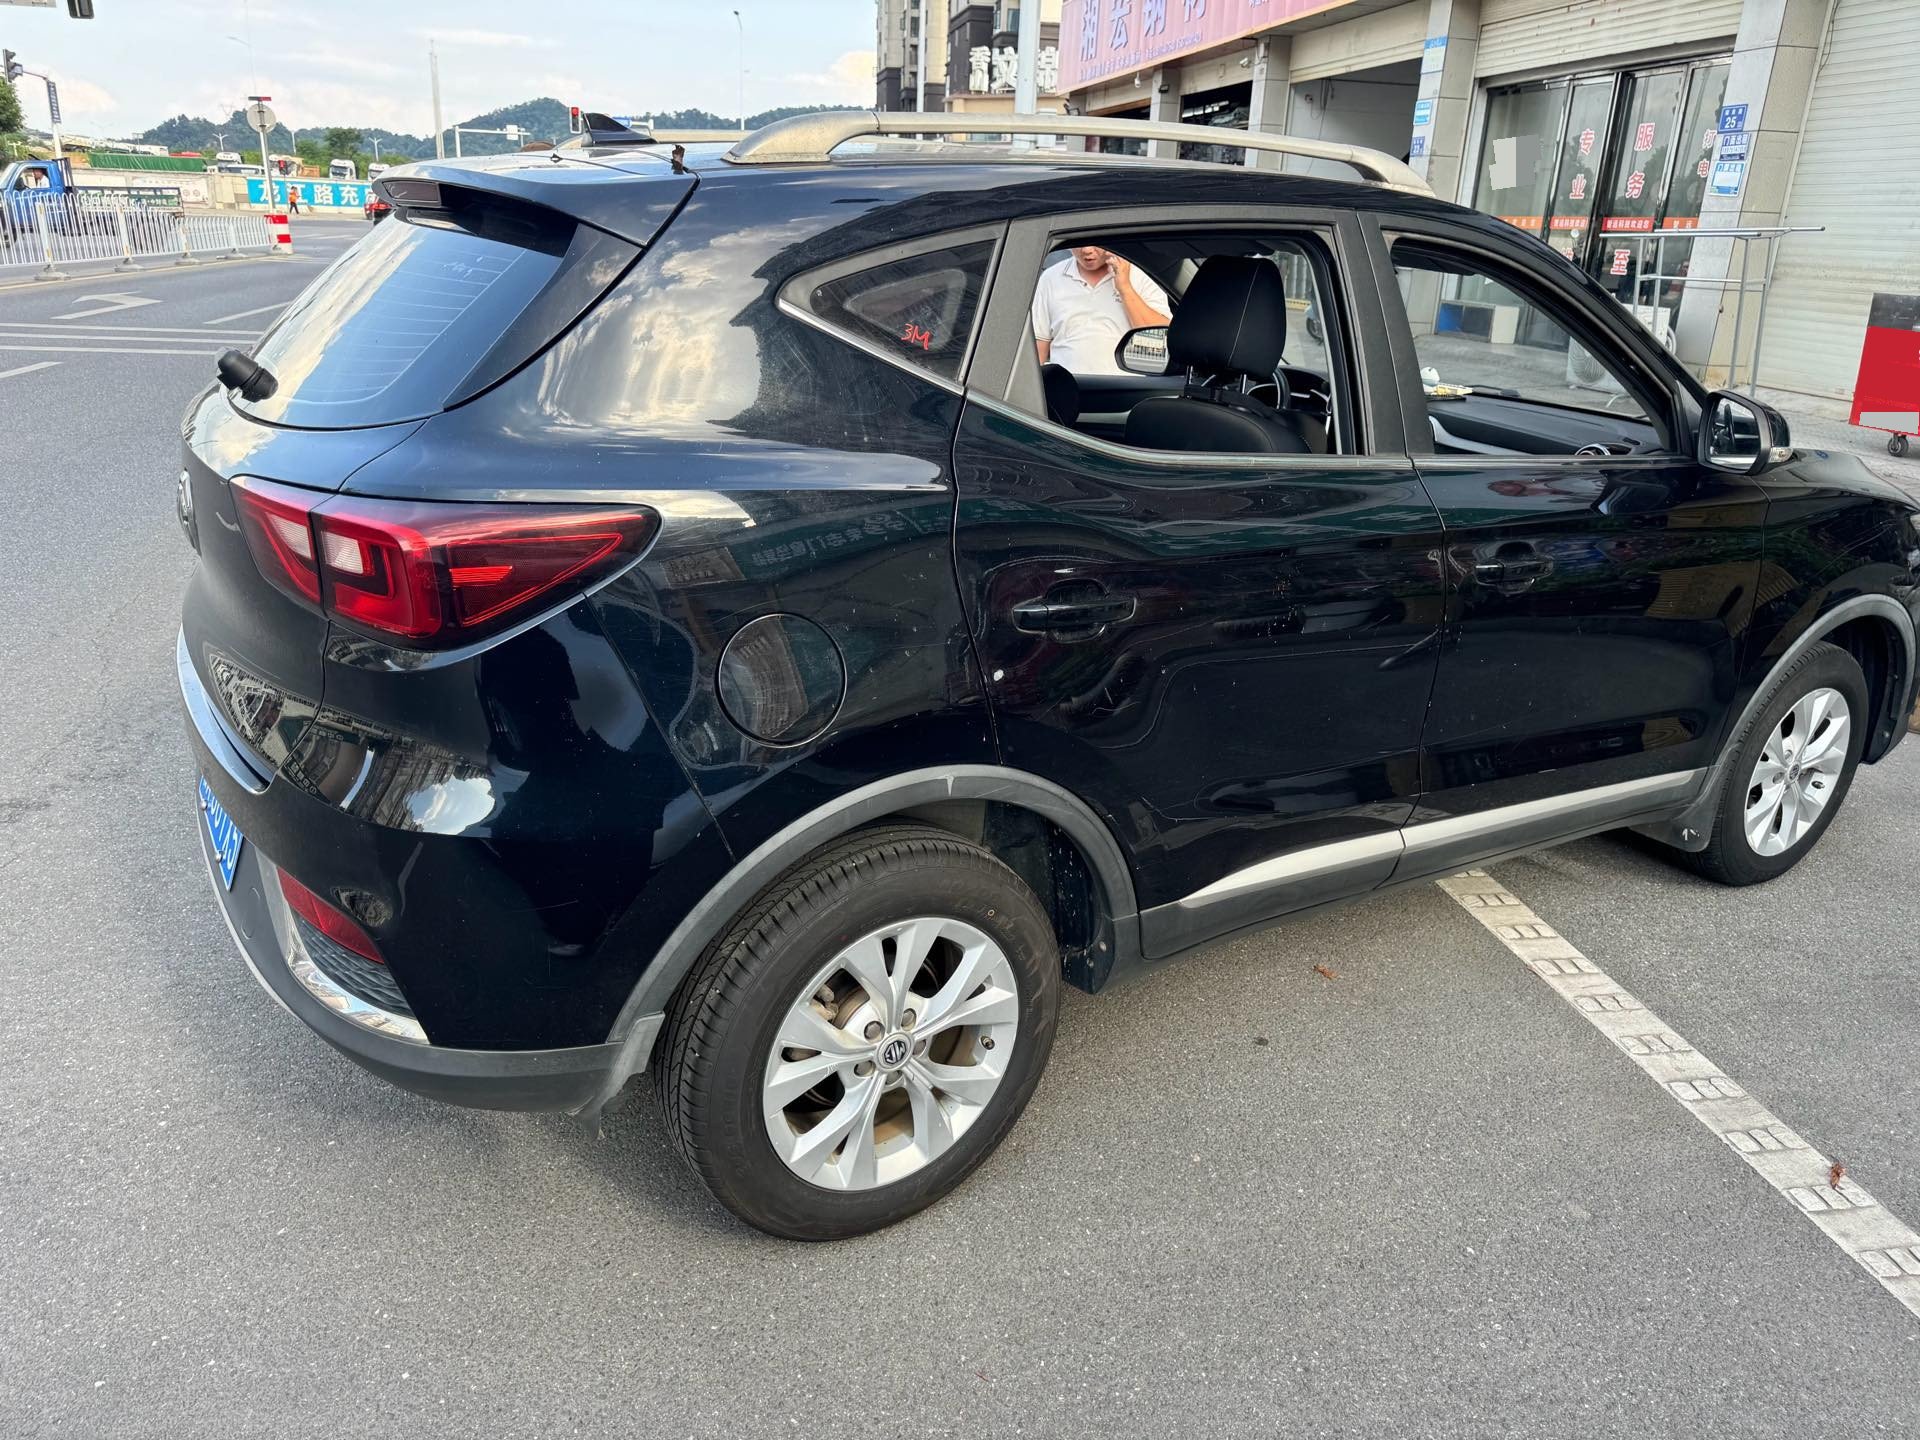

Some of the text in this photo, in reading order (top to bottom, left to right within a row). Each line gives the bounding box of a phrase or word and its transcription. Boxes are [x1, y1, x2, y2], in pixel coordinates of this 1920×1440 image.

[1724, 116, 1737, 129] 25
[1610, 250, 1631, 275] 至
[901, 323, 930, 351] 3M
